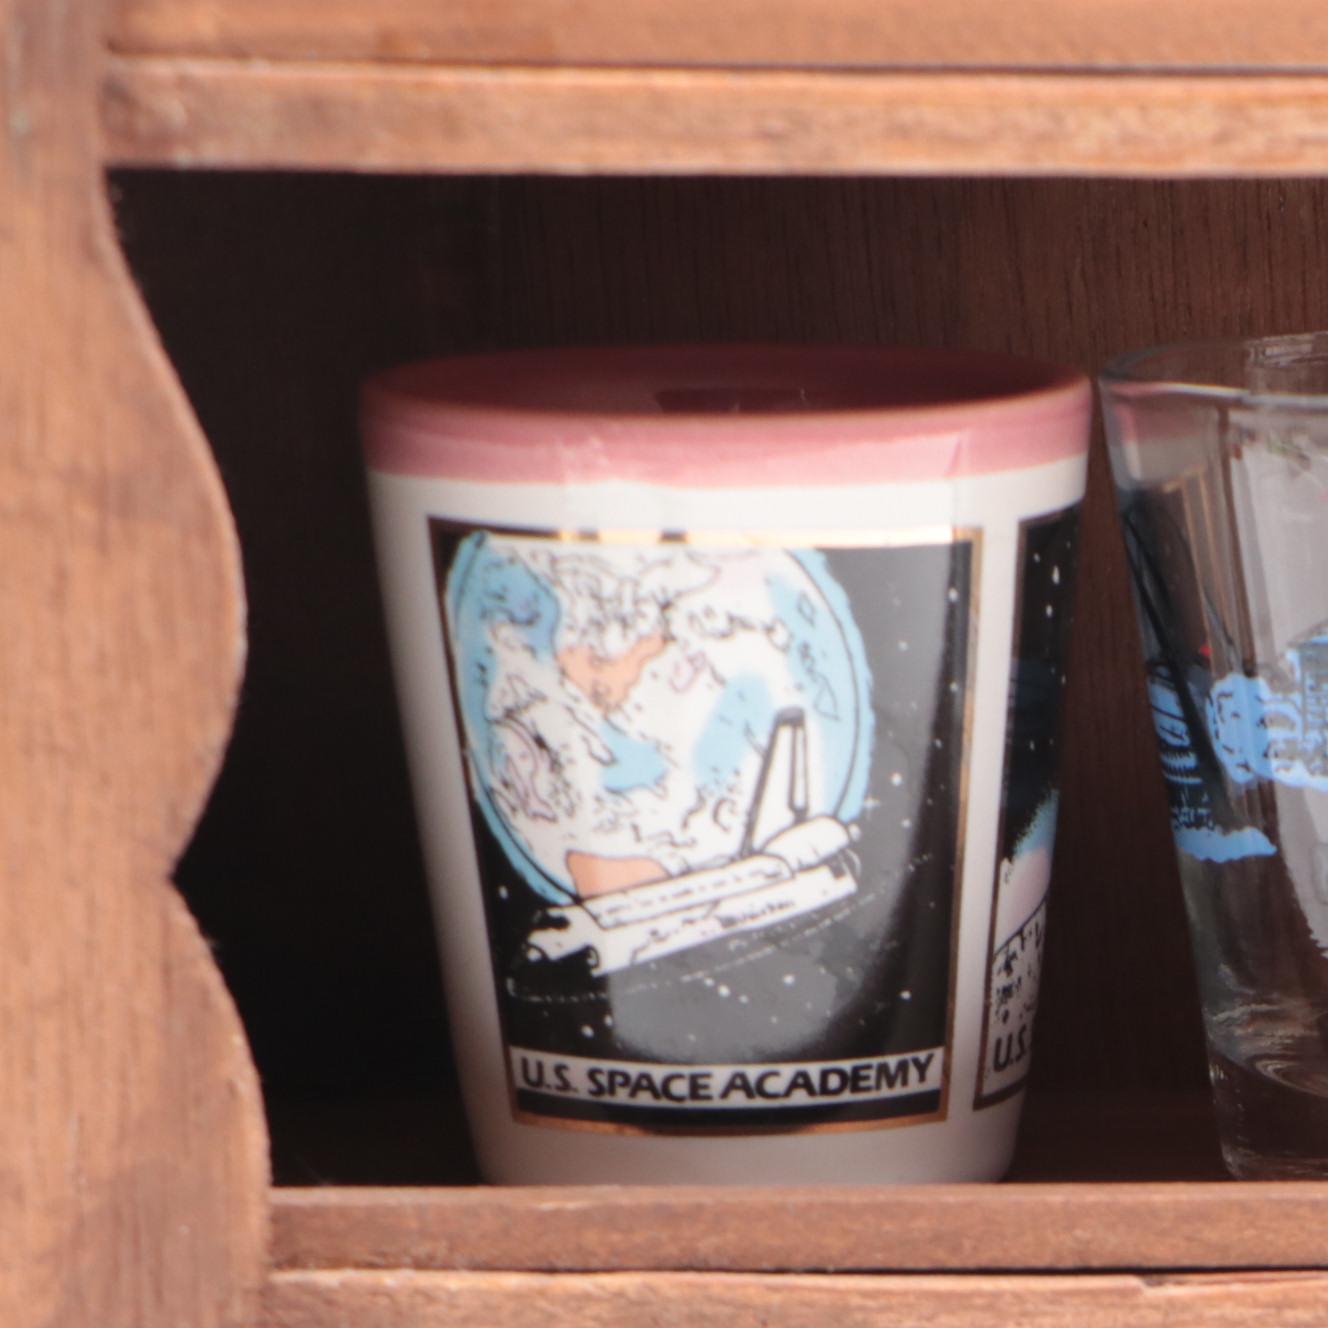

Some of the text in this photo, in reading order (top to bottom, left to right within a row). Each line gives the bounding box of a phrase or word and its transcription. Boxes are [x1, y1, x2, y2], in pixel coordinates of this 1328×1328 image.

[520, 1053, 935, 1102] U.S. SPACE ACADEMY
